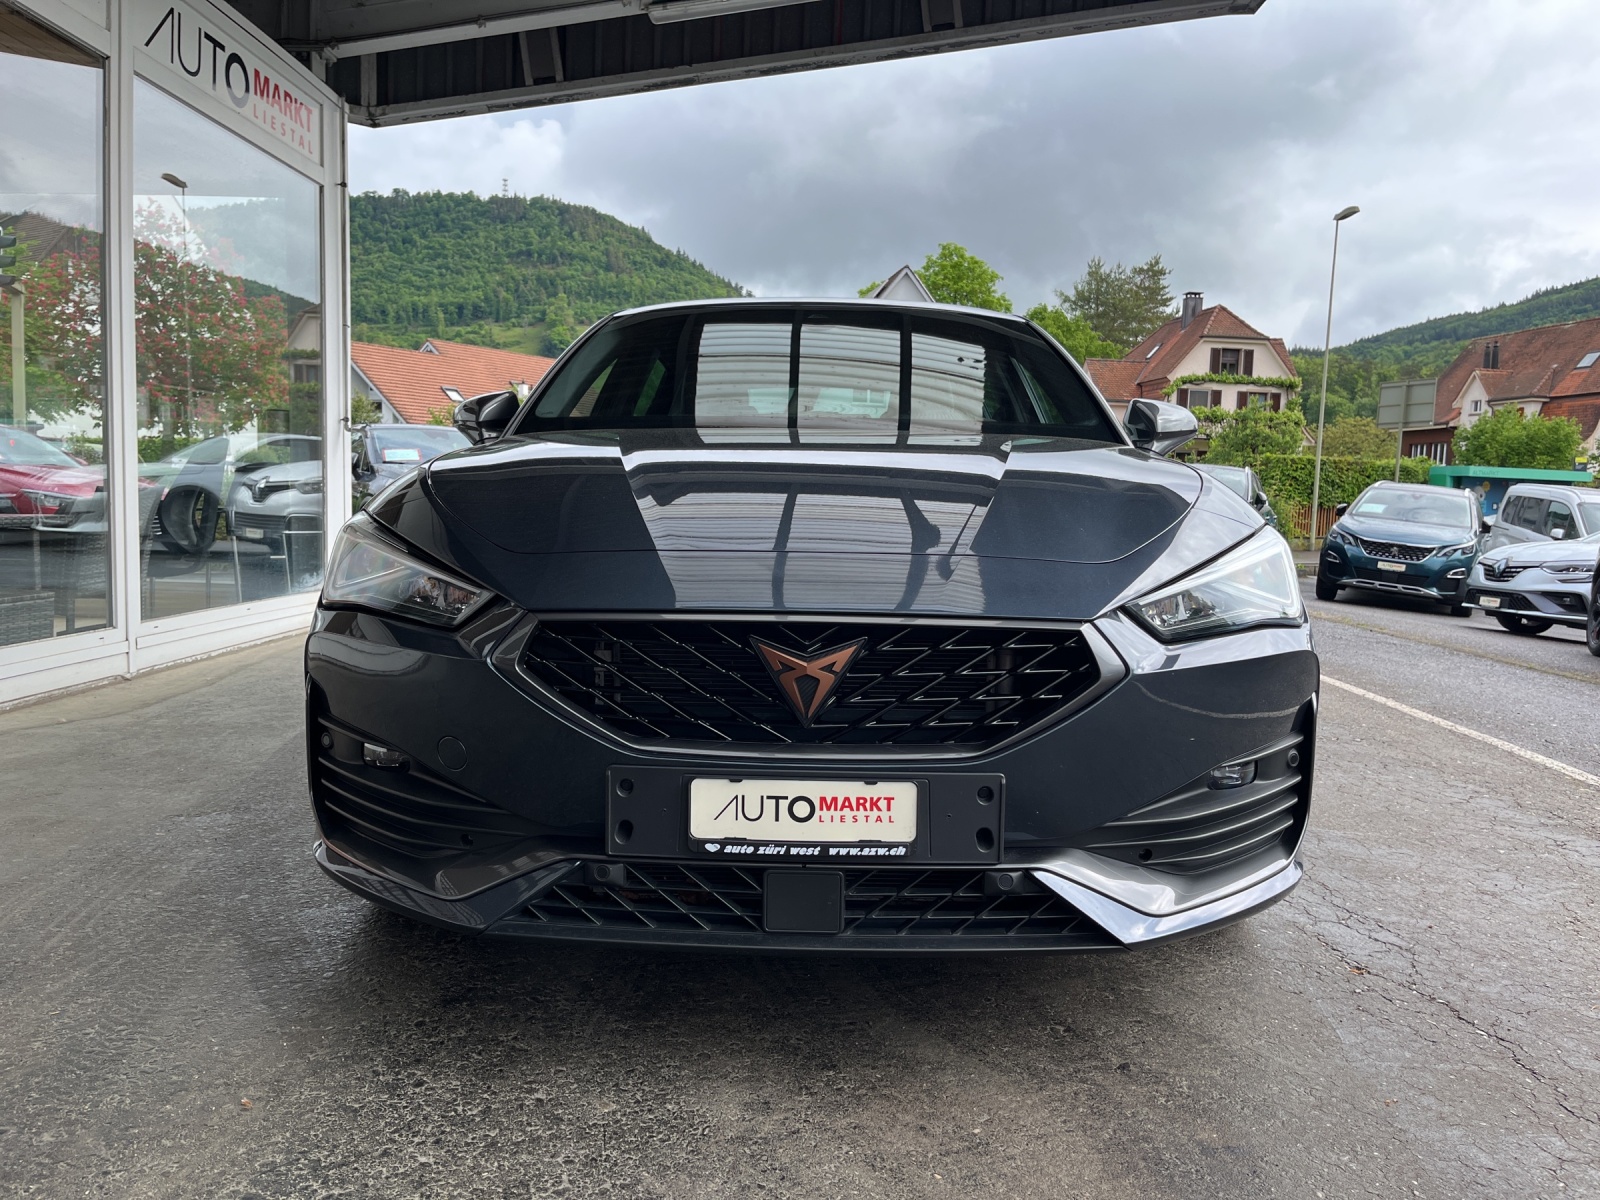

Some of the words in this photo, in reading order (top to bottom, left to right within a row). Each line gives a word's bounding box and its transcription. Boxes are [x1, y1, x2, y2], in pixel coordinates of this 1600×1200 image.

[144, 7, 250, 108] AUTO
[253, 68, 313, 133] MARKT
[253, 104, 313, 155] LIESTAL
[714, 794, 816, 823] AUTO
[819, 796, 895, 812] MARKT
[819, 815, 895, 823] LIESTAL
[724, 845, 754, 854] auto
[757, 844, 787, 855] züri
[790, 846, 821, 855] west
[829, 846, 907, 856] www.azw.ch
